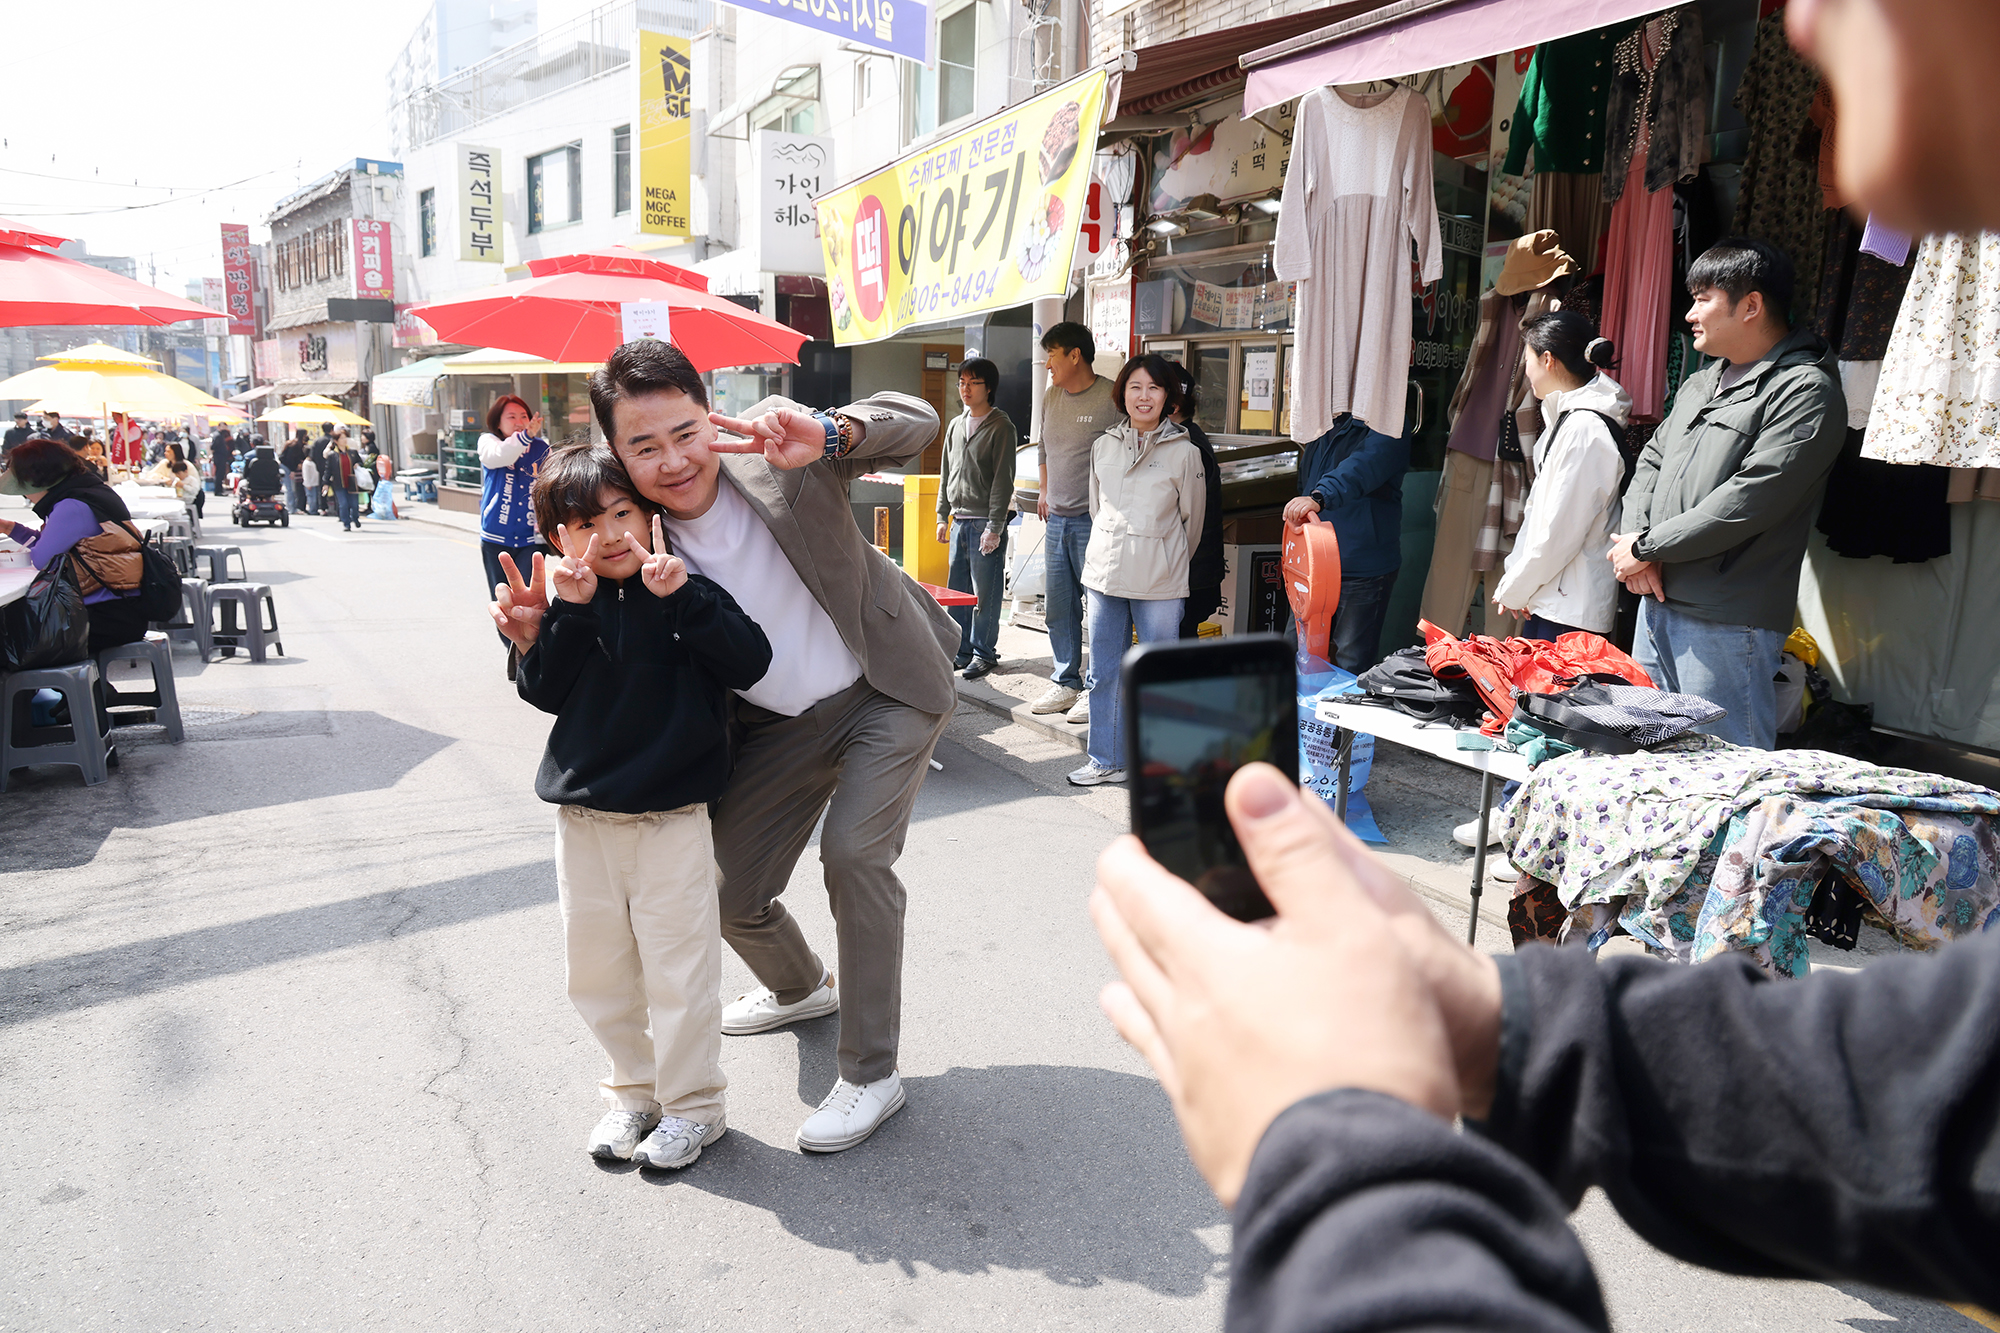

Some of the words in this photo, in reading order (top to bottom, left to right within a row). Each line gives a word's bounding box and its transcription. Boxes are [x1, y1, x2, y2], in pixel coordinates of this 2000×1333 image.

[968, 120, 1018, 170] 전문점
[468, 151, 494, 256] 즉석두부
[646, 186, 677, 201] MEGA
[646, 200, 671, 213] MGC
[646, 213, 686, 229] COFFEE
[898, 151, 1026, 285] 이야기
[362, 236, 384, 288] 커피숍
[1076, 415, 1093, 423] 1950
[1262, 560, 1282, 590] 떡
